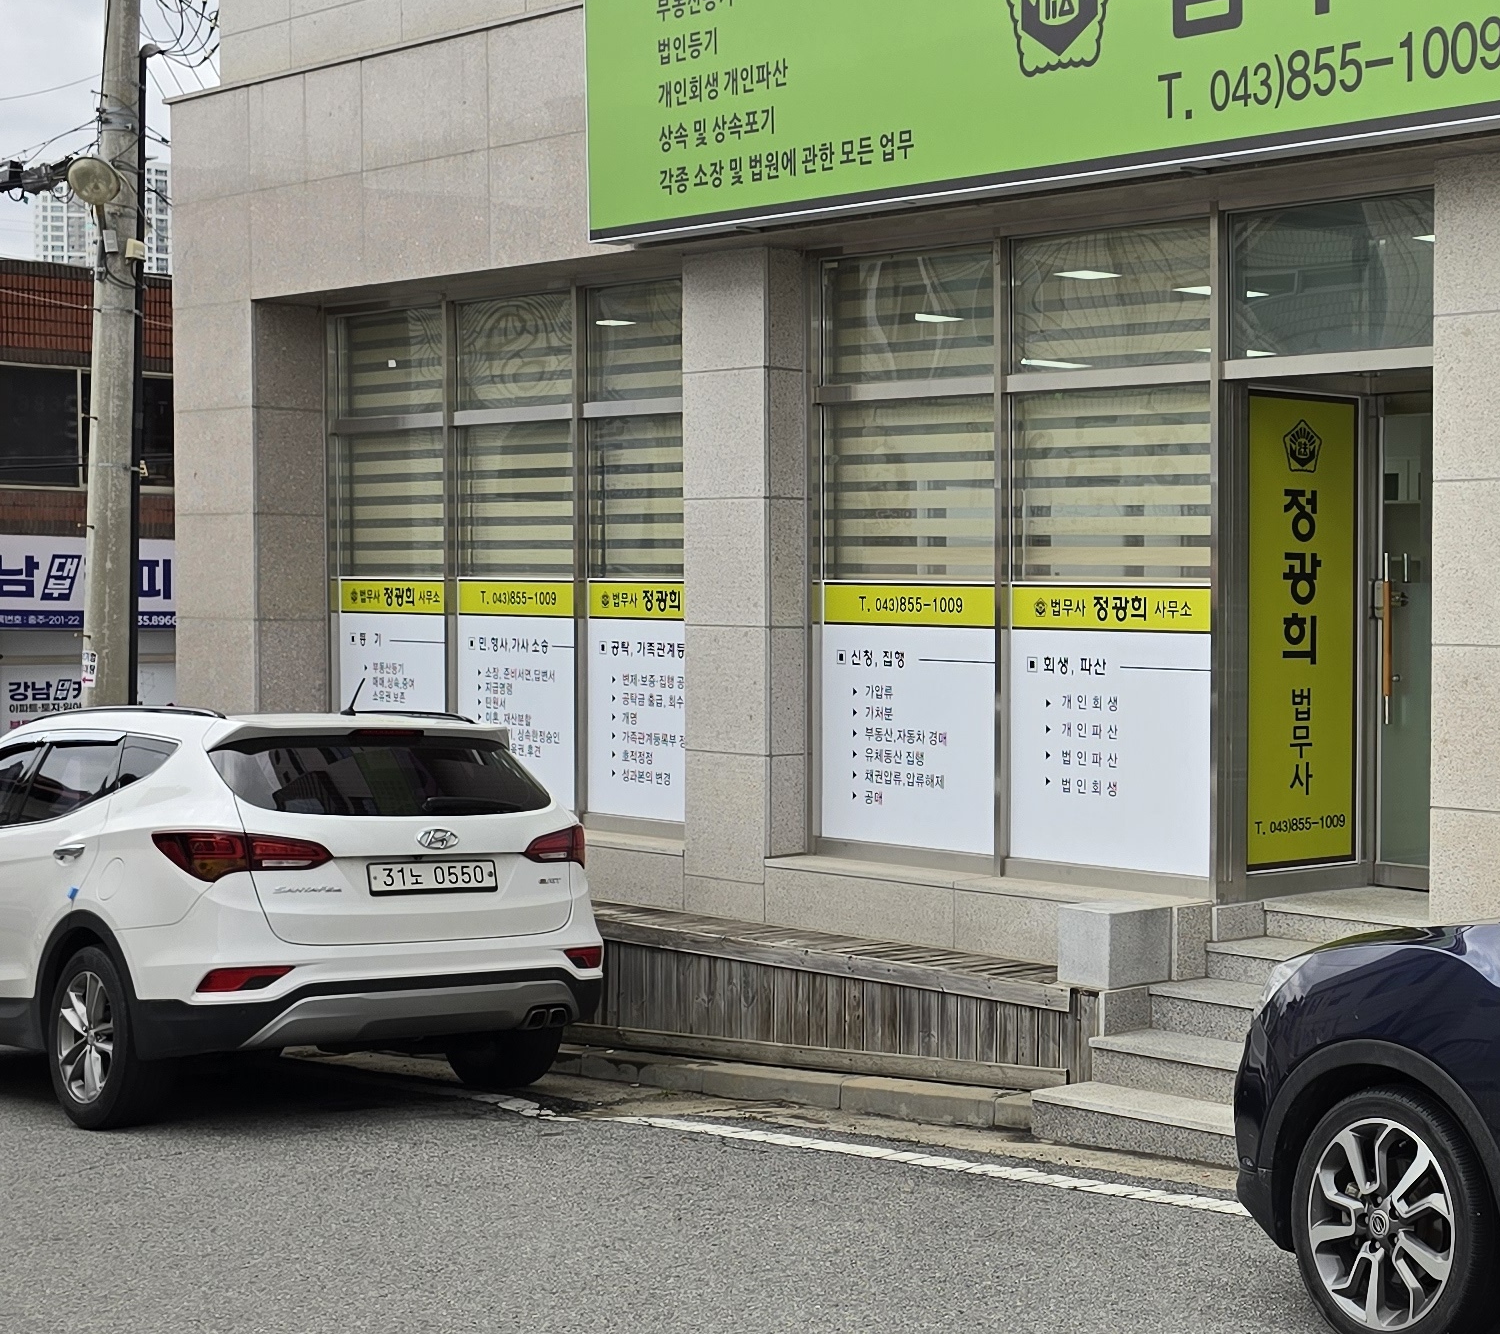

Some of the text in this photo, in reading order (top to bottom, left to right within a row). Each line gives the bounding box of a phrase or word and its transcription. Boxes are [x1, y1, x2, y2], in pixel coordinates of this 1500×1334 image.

[658, 27, 718, 66] 법인등기
[658, 58, 789, 108] 개인회생 개인파산
[658, 105, 775, 153] 상속 및 상속포기
[659, 129, 915, 196] 각종 소장 및 법원에 관한 모든 업무
[360, 587, 440, 607] 법무사 정광희 사무소
[612, 589, 681, 612] 법무사 정광희
[1051, 596, 1192, 621] 법무사 정광희 사무소
[883, 650, 904, 668] 집행
[1080, 657, 1106, 676] 파산
[9, 681, 52, 701] 강남
[622, 693, 645, 706] 공탁금
[865, 685, 893, 699] 가압류
[1289, 687, 1313, 796] 법무사
[865, 748, 902, 764] 유체동산
[655, 772, 671, 786] 변경
[382, 865, 484, 887] 31노 0550
